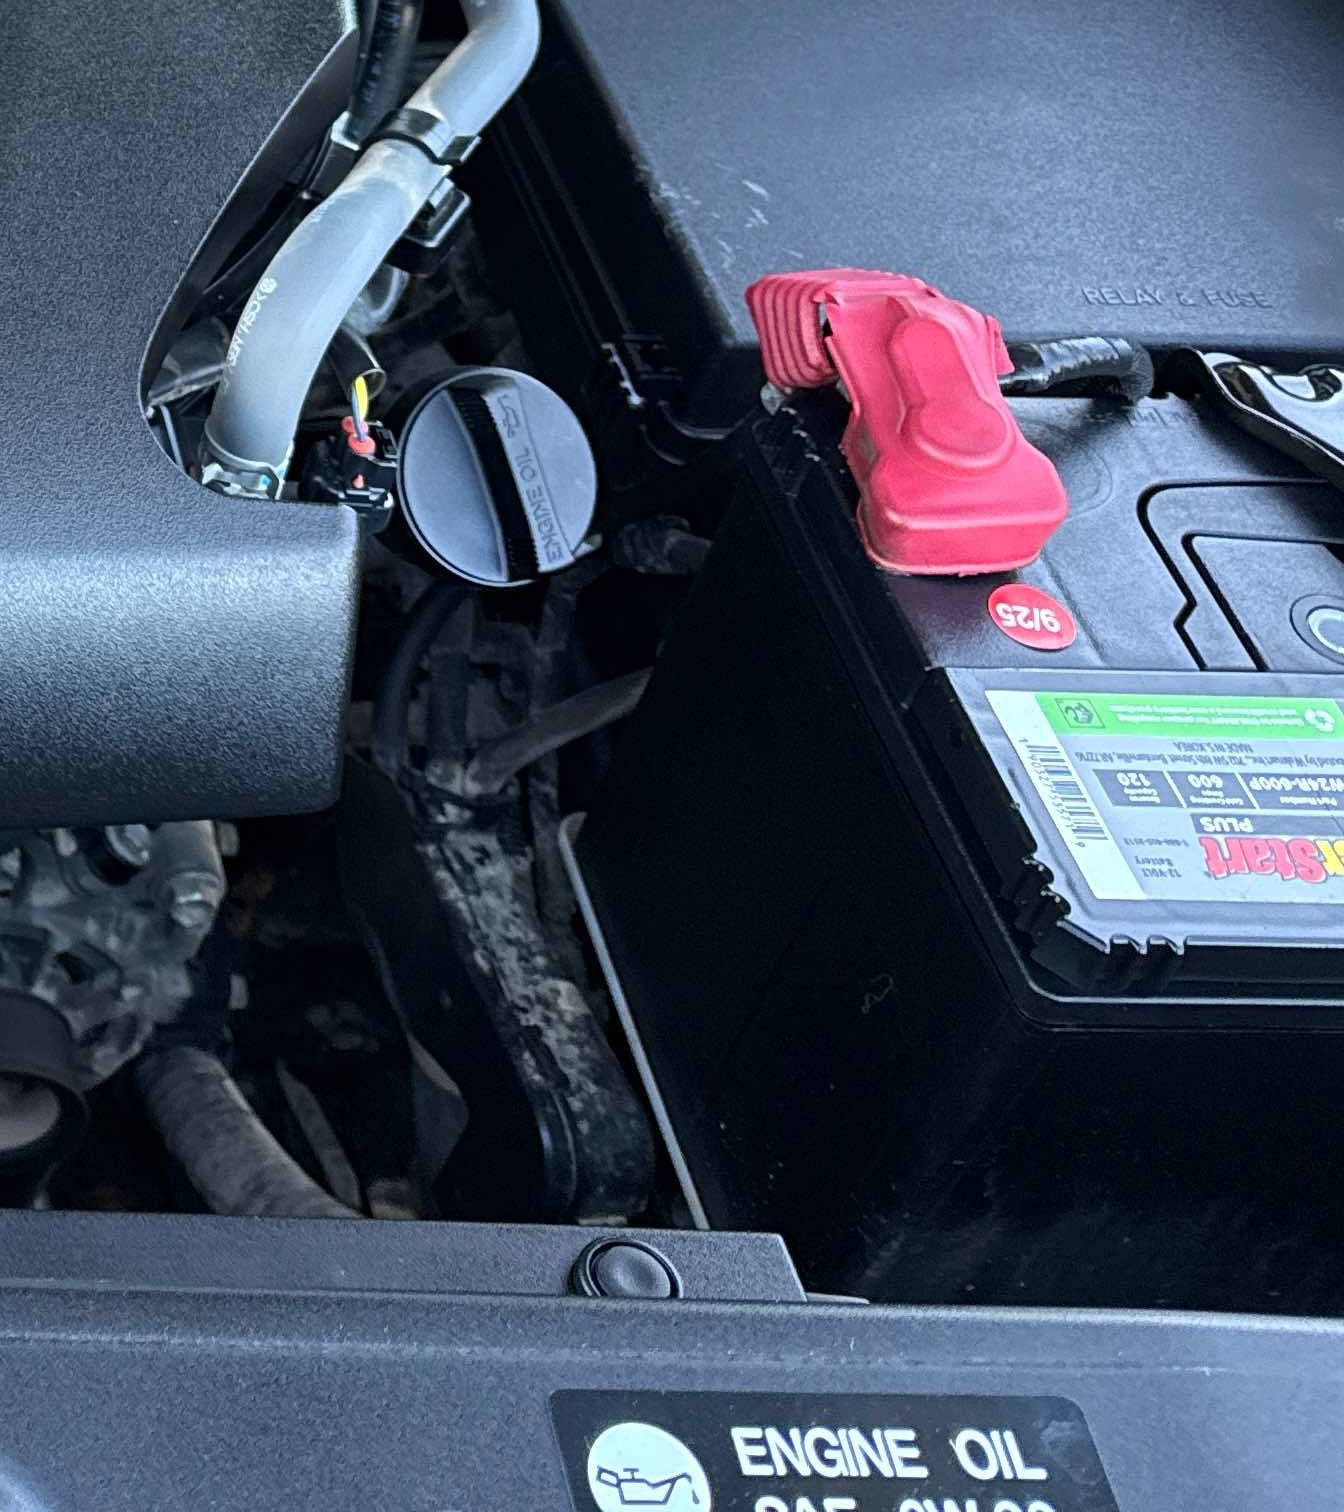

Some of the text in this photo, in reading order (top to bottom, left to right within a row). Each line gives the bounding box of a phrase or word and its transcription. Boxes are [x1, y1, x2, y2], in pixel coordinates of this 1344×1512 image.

[1081, 286, 1165, 308] RELAY
[1206, 287, 1275, 309] FUSE
[520, 443, 539, 484] OIL
[995, 601, 1062, 635] 9/25
[1115, 771, 1152, 787] 120
[1187, 773, 1224, 789] 600
[1198, 816, 1255, 833] PLUS
[730, 1427, 1048, 1480] ENGINE OIL
